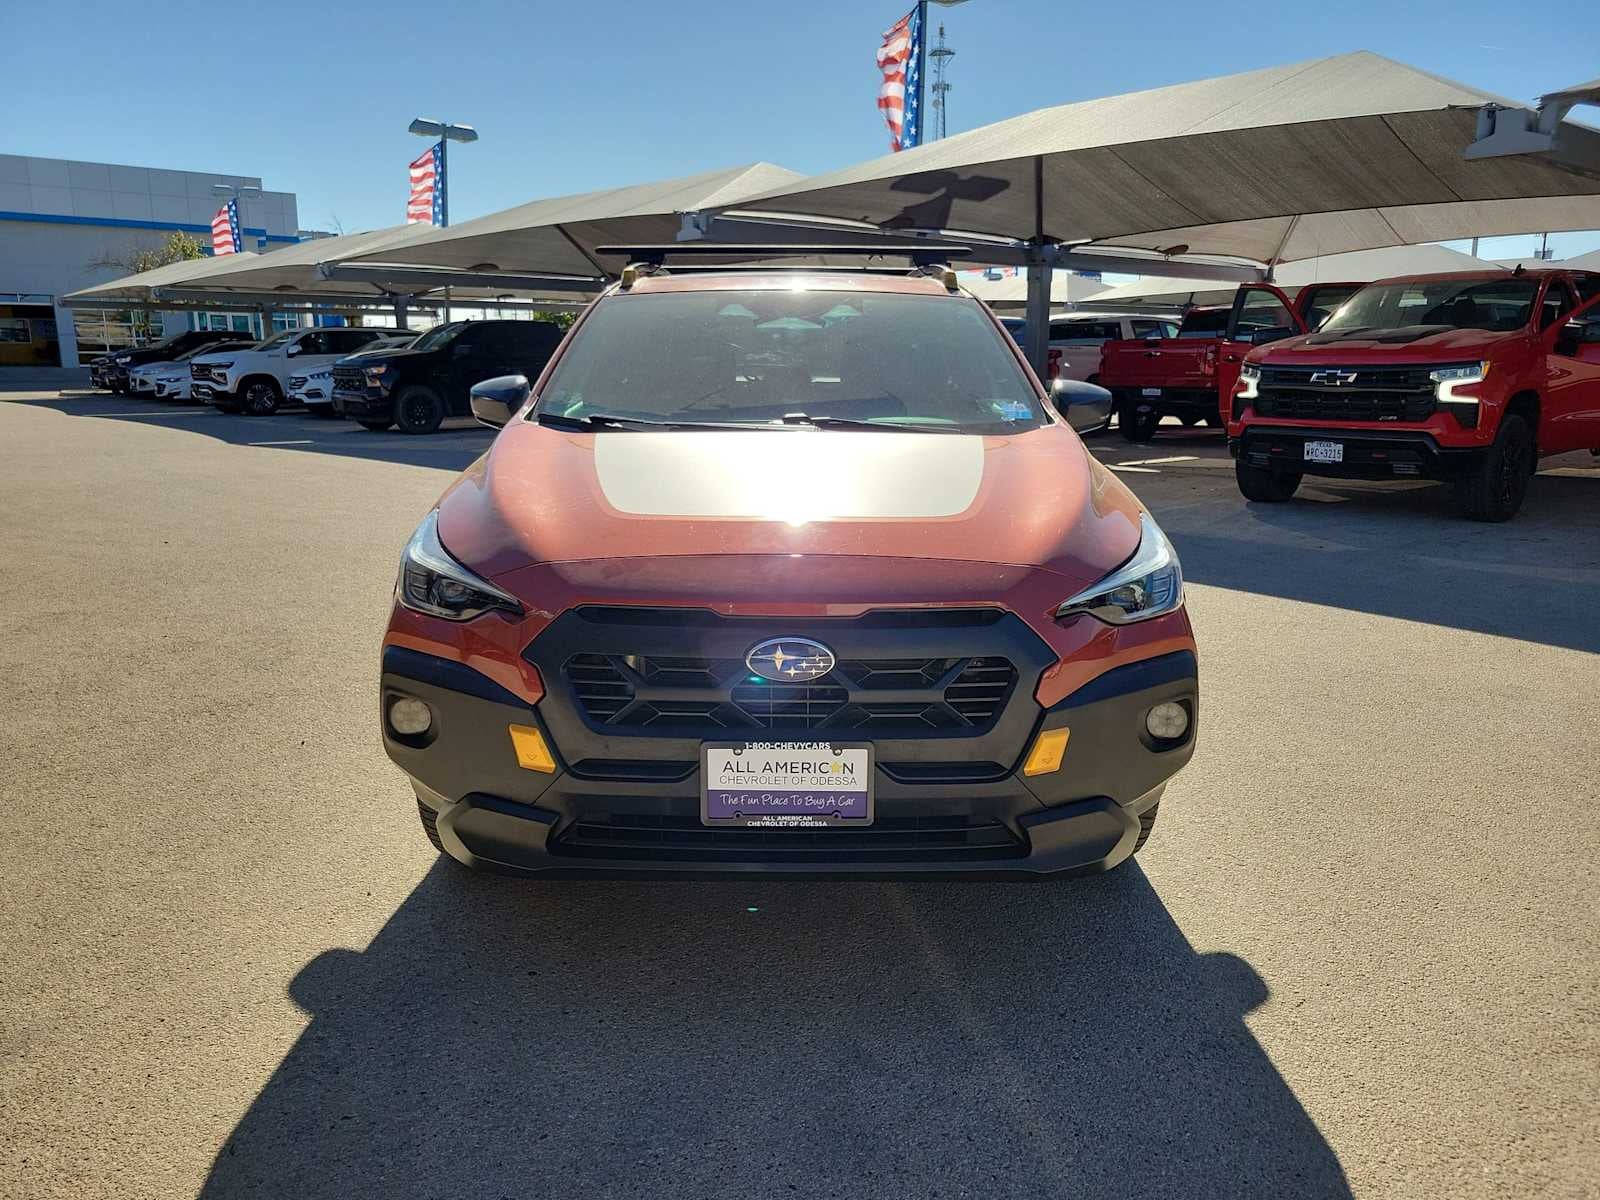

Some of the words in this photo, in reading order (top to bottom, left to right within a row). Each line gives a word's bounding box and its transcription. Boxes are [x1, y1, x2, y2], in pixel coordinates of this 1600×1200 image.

[745, 742, 831, 750] 1-800-CHEVYCARS
[723, 761, 755, 773] ALL
[720, 775, 788, 785] CHEVROLET
[791, 776, 807, 785] OF
[810, 776, 857, 785] ODESSA
[720, 794, 740, 805] The
[741, 794, 759, 805] Fun
[762, 793, 789, 806] Place
[789, 794, 802, 806] To
[804, 795, 825, 809] Buy
[826, 795, 836, 806] A
[837, 795, 856, 806] Car
